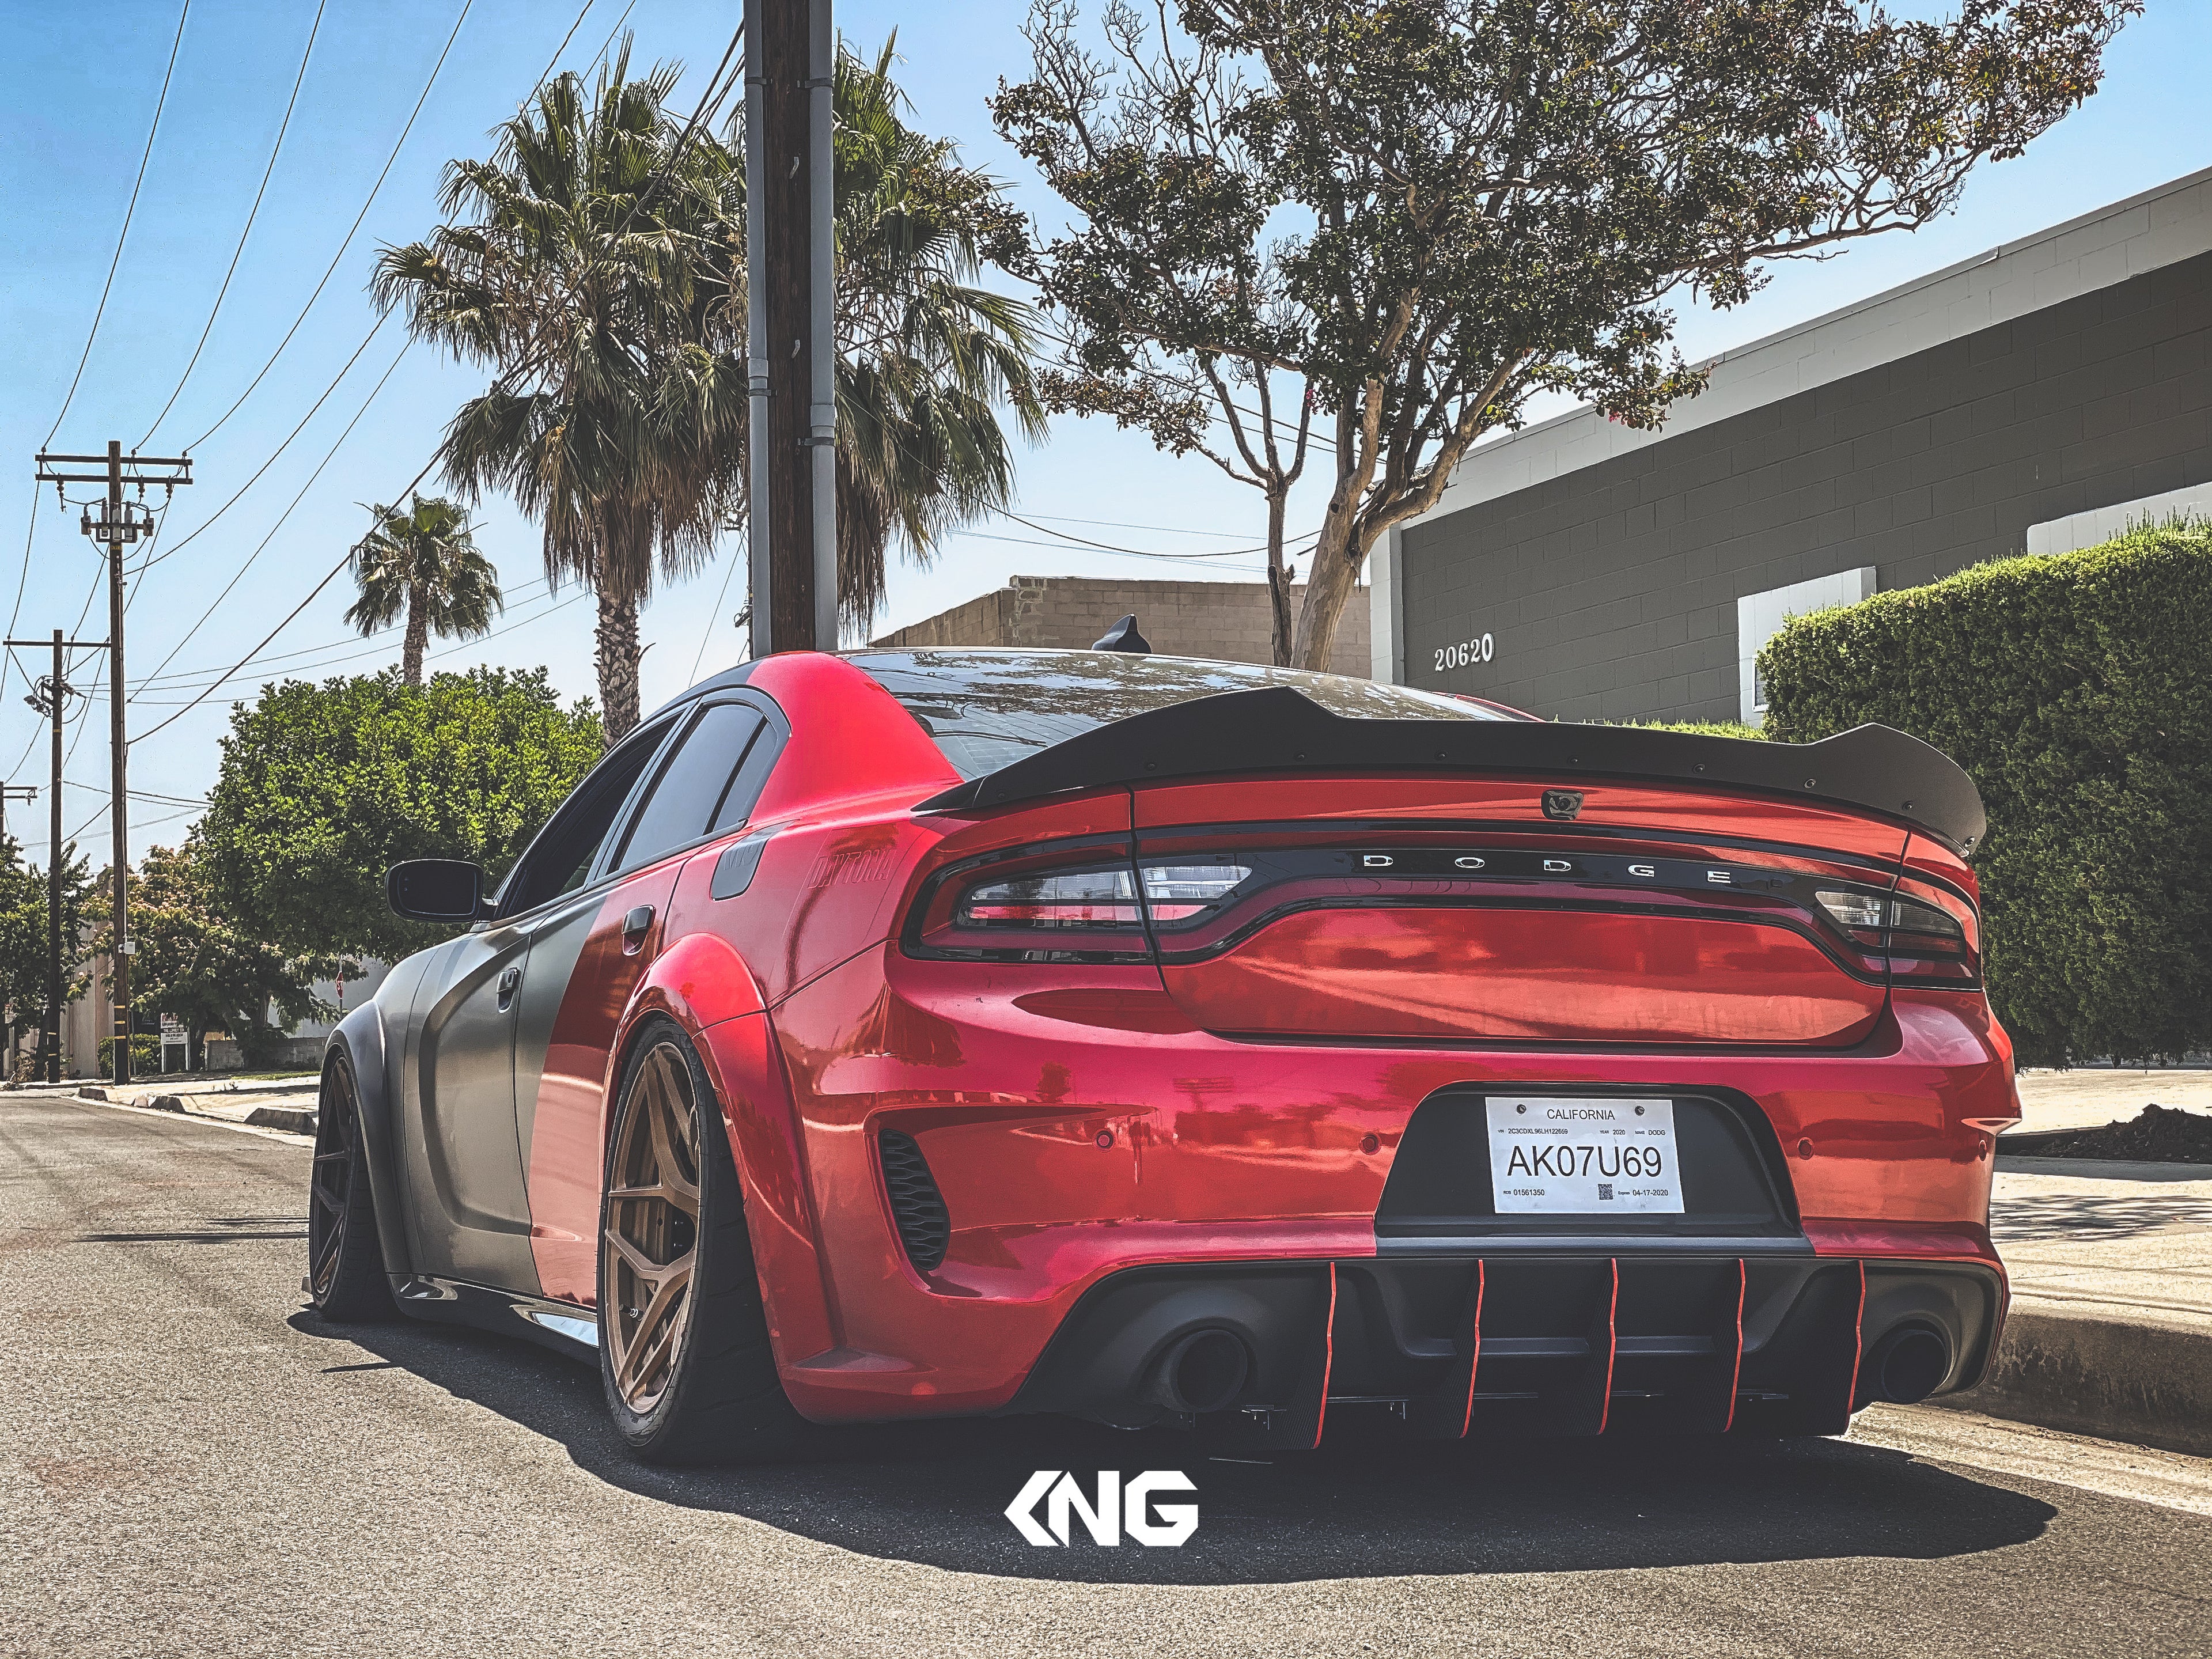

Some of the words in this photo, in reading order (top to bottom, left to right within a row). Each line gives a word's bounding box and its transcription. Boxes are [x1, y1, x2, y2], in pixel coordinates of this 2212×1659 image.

[1434, 632, 1495, 672] 20620
[807, 848, 896, 889] DAYTONA
[1363, 855, 1730, 884] DODGE
[1547, 1109, 1616, 1120] CALIFORNIA
[1507, 1145, 1662, 1177] AK07U69
